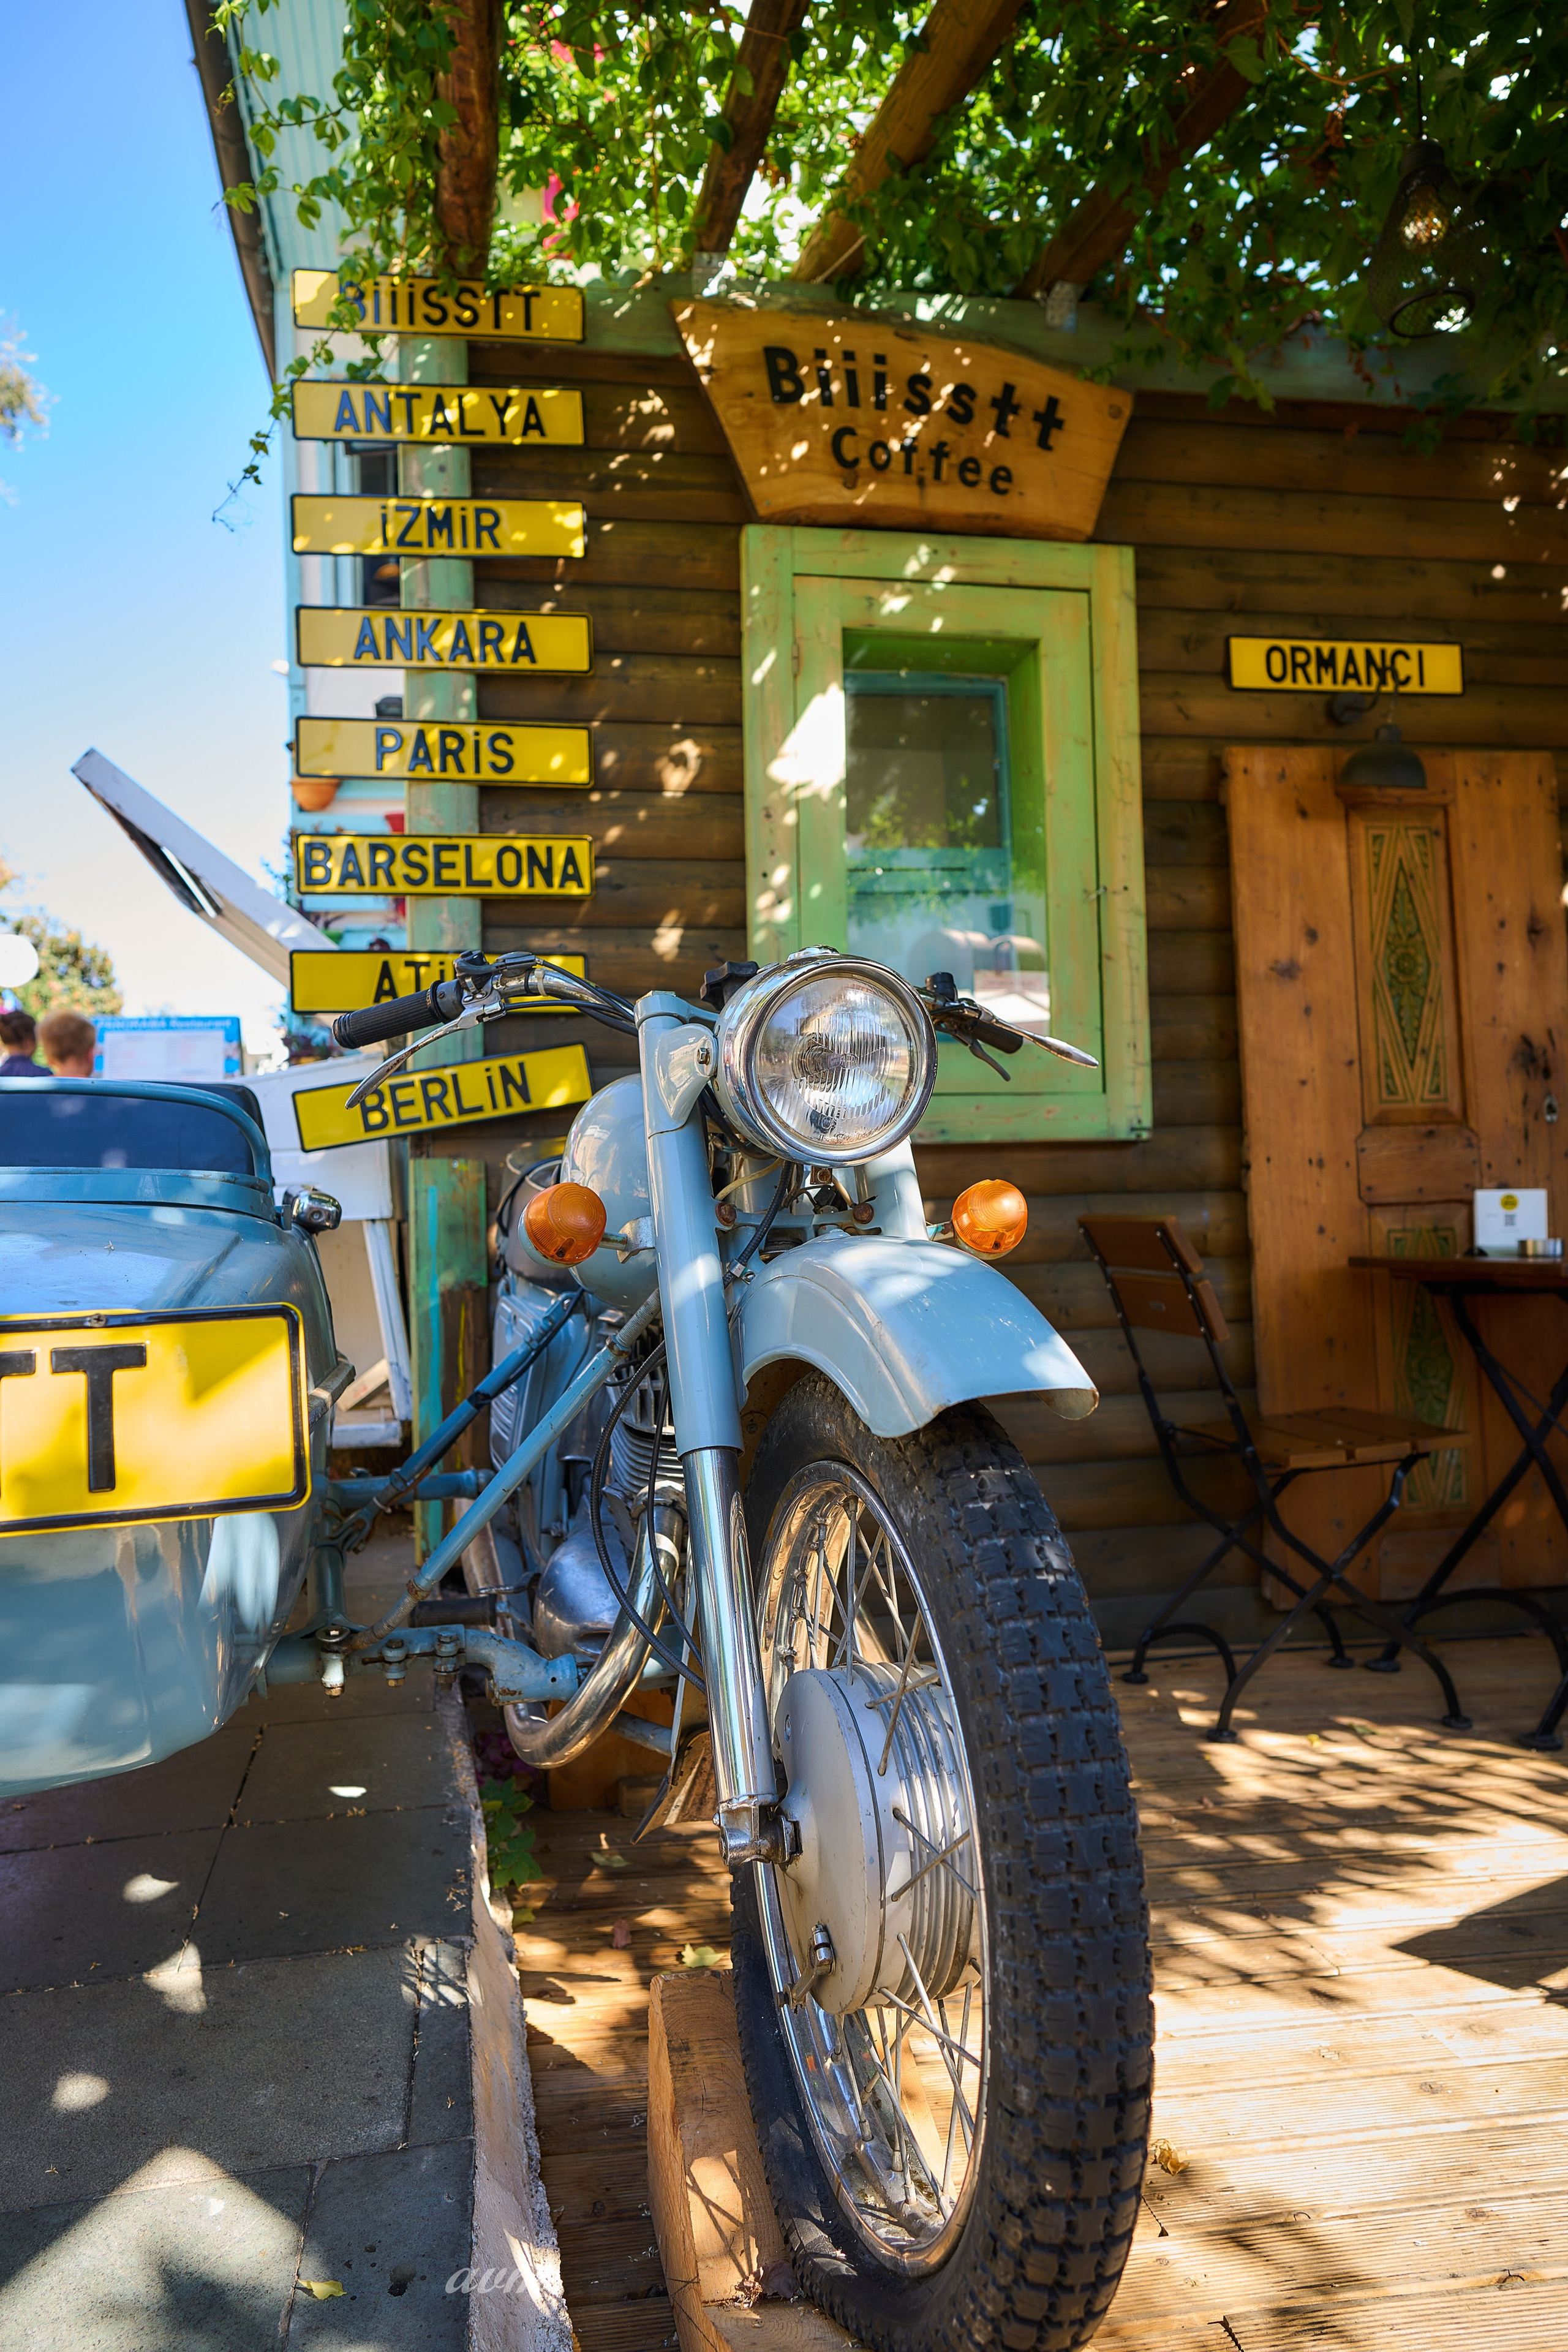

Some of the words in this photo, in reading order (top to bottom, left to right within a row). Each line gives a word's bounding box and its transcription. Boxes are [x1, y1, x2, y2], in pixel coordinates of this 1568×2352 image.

[333, 389, 547, 438] ANTALYA
[831, 426, 1014, 496] Coffee
[353, 616, 537, 665] ANKARA
[1265, 645, 1425, 687] ORMANCI
[304, 842, 584, 889] BARSELONA
